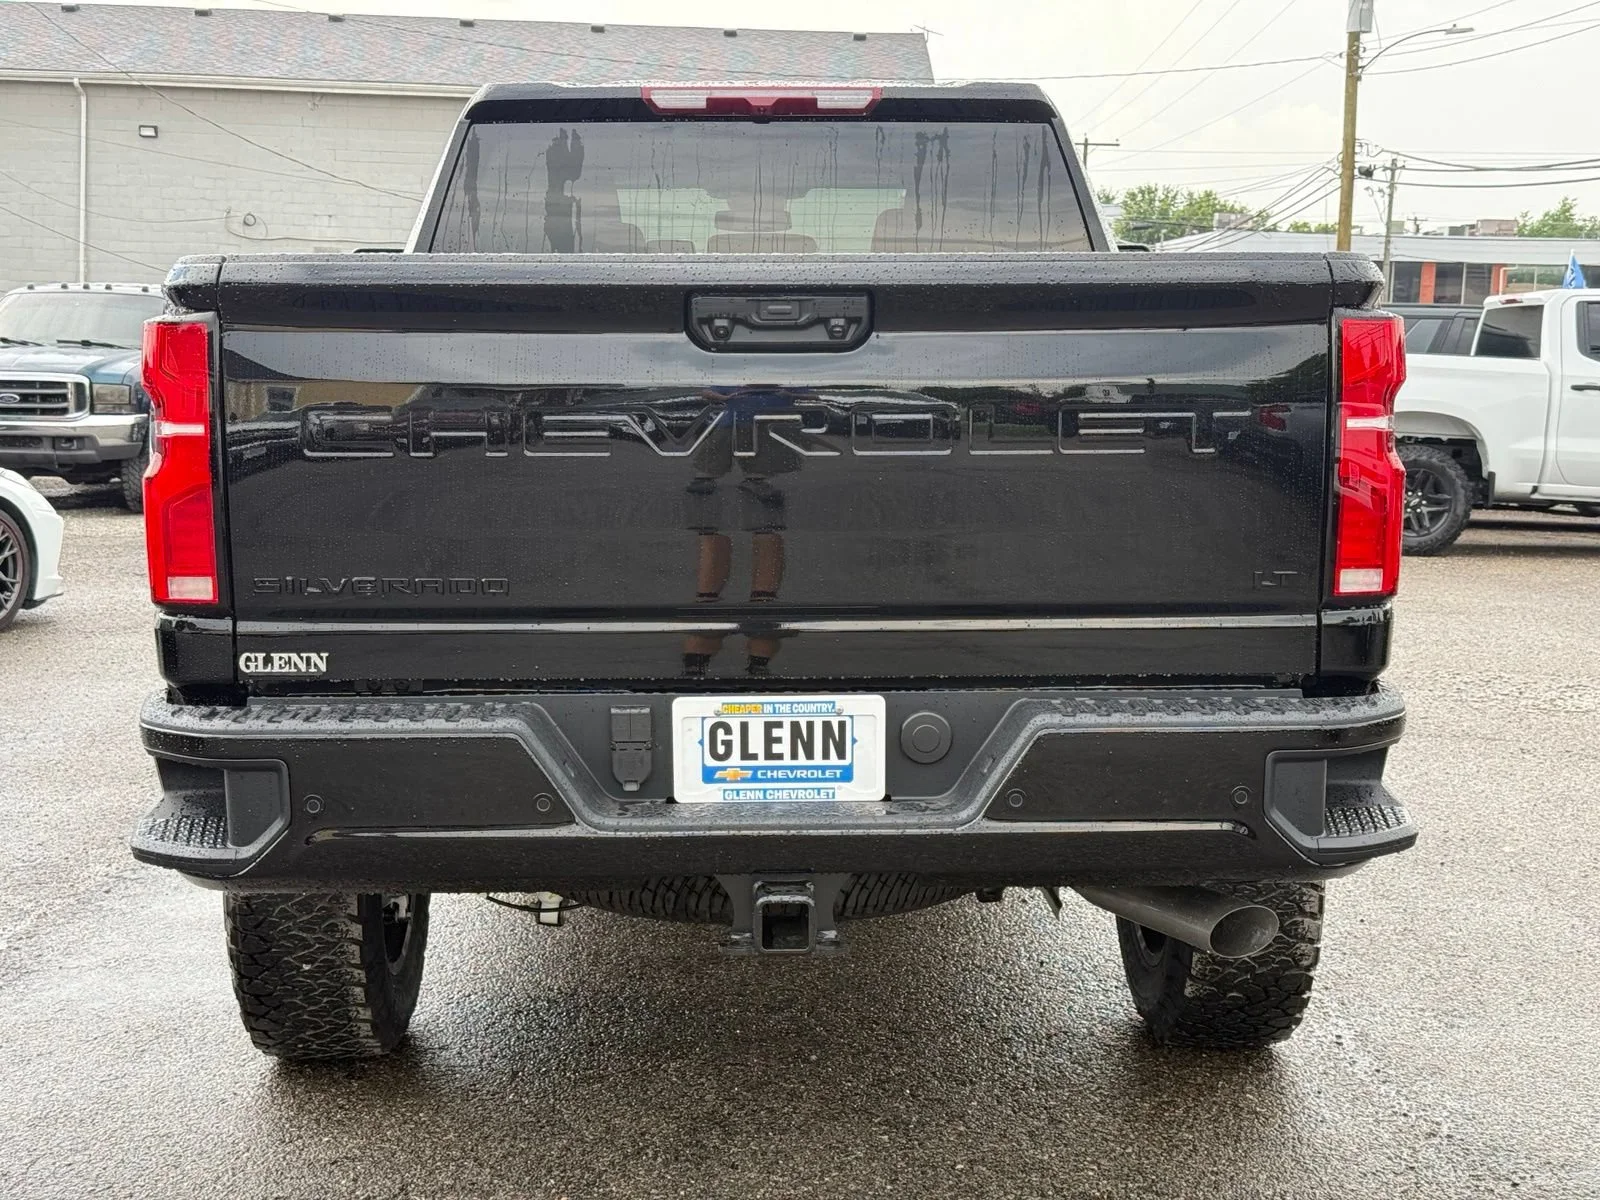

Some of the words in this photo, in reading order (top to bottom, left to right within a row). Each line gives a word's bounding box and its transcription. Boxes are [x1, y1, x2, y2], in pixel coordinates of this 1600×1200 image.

[302, 405, 1253, 457] CHEVROLET
[252, 576, 510, 595] SILVERADO
[1252, 570, 1298, 590] LT
[238, 652, 329, 673] GLENN
[722, 703, 762, 714] CHEAPER
[763, 703, 773, 714] IN
[774, 703, 791, 714] THE
[792, 702, 835, 714] COUNTRY.
[708, 720, 847, 762] GLENN
[757, 769, 843, 779] CHEVROLET
[724, 789, 764, 800] GLENN
[766, 788, 834, 800] CHEVROLET
